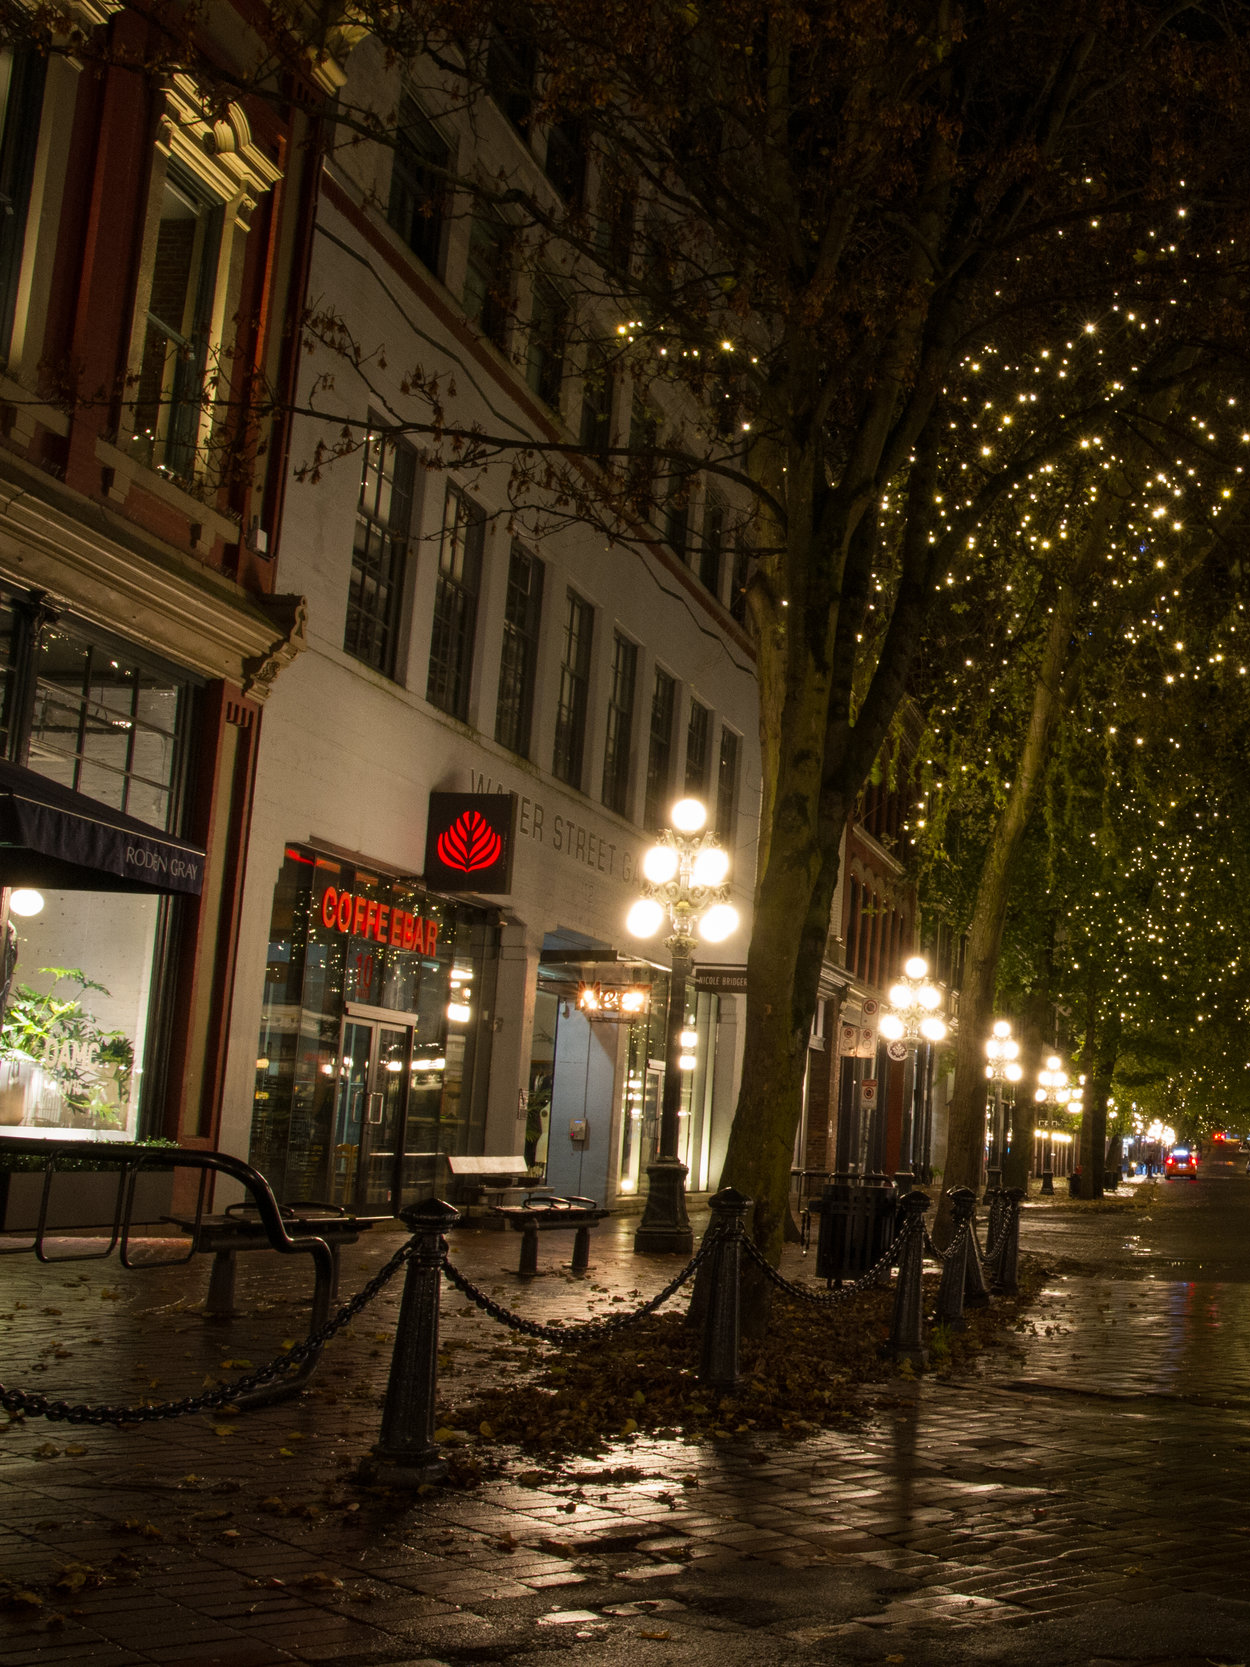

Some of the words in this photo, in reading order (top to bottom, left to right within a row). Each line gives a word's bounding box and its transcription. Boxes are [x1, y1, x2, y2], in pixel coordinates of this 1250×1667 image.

[126, 846, 168, 873] RODEN
[170, 858, 198, 881] GRAY
[553, 815, 617, 875] STREET
[322, 886, 438, 957] COFFEEBAR
